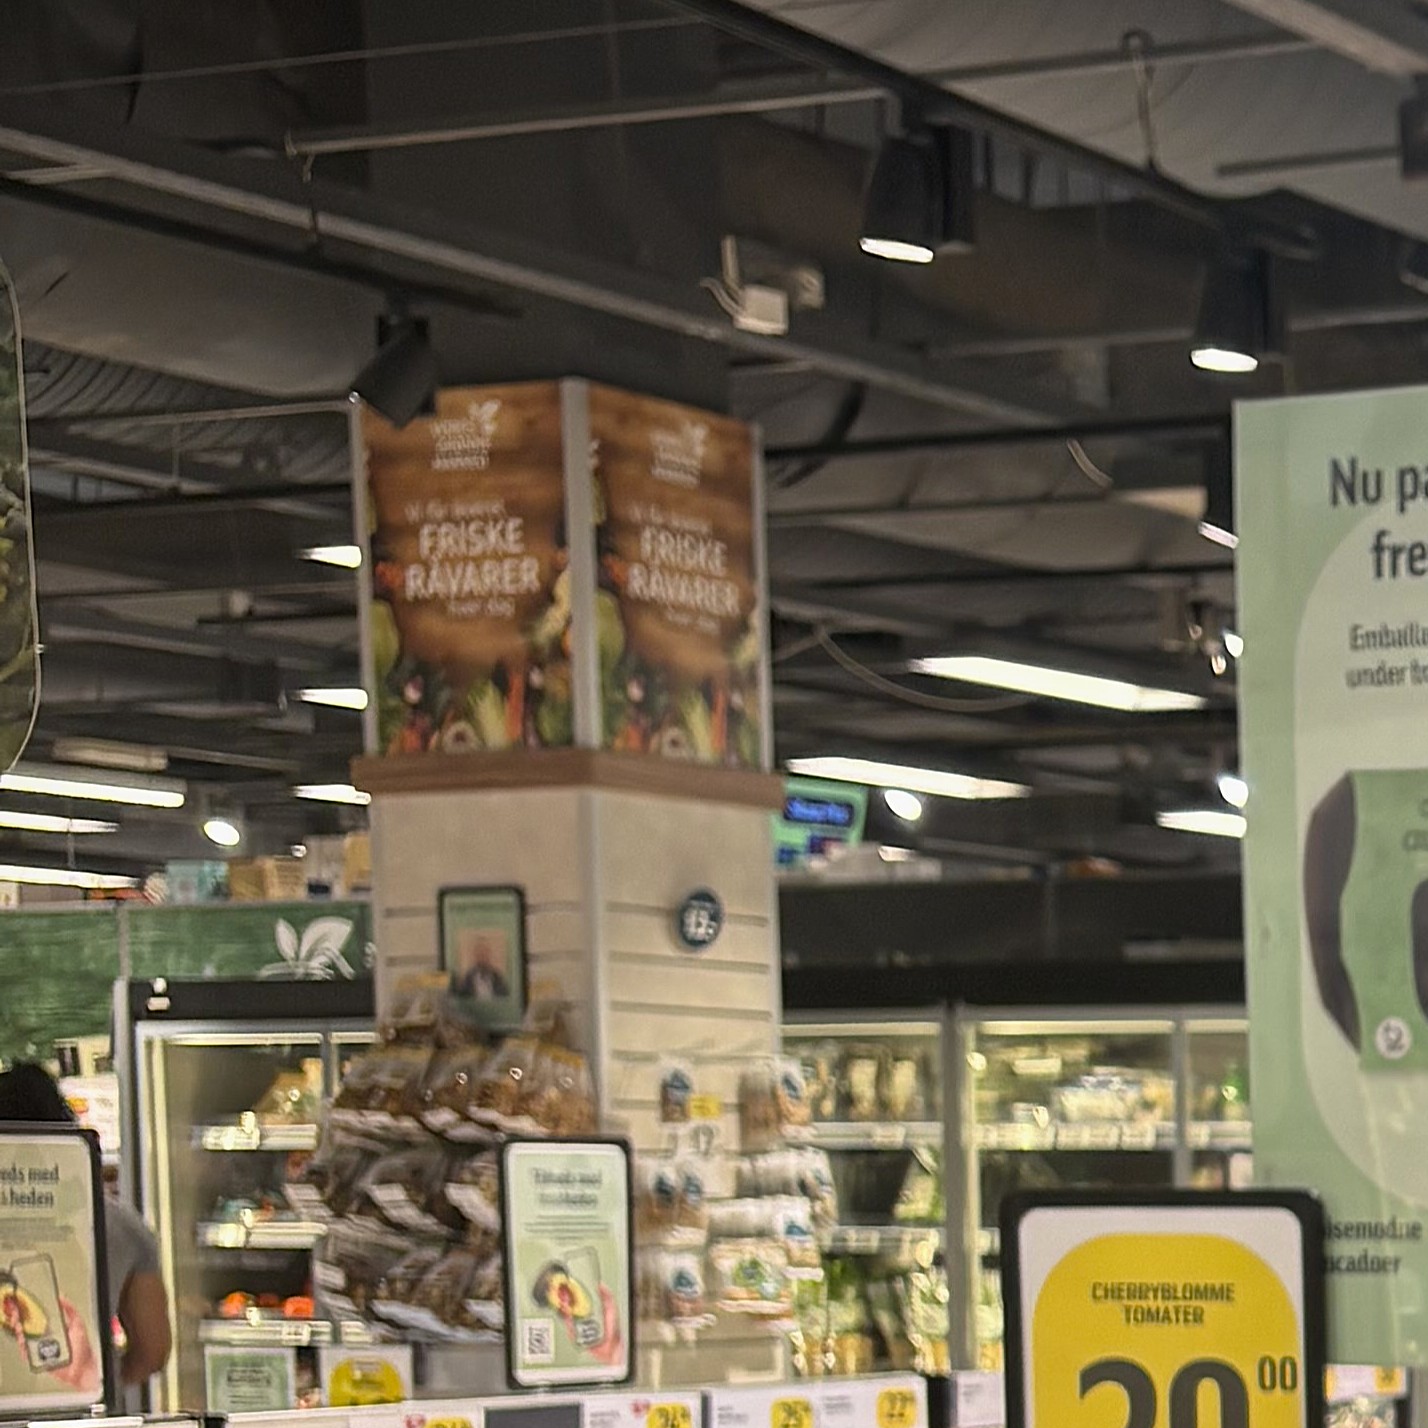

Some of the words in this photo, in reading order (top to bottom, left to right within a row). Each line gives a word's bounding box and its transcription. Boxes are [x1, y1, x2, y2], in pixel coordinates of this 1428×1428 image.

[1329, 456, 1383, 507] Nu
[419, 519, 525, 559] FRISKE
[640, 526, 728, 576] FRISKE
[403, 553, 541, 602] RÅVARER
[1346, 660, 1408, 688] under
[1091, 1281, 1236, 1303] CHERRYBLOMME
[1123, 1304, 1205, 1326] TOMATER
[1257, 1355, 1298, 1392] 00
